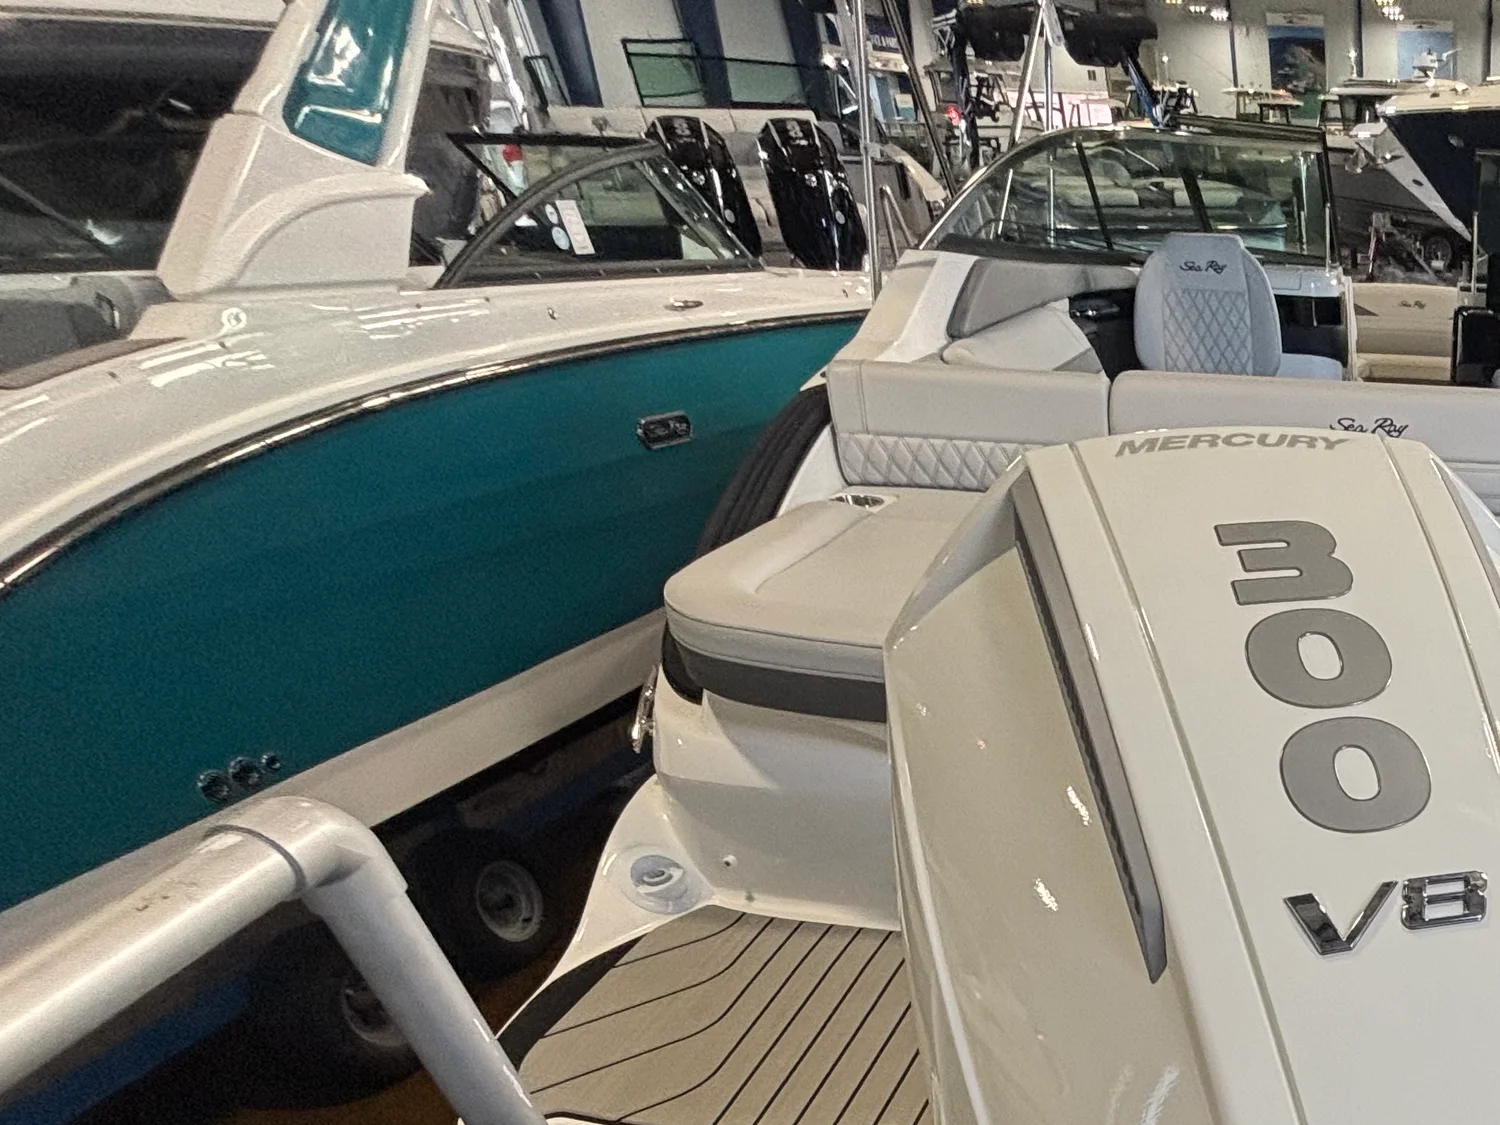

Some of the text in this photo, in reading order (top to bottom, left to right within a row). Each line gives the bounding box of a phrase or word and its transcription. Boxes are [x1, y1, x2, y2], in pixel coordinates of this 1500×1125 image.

[1179, 259, 1228, 275] Sea Ray
[1329, 417, 1409, 438] Sea Ray
[1115, 432, 1351, 457] MERCURY
[1213, 519, 1432, 834] 300
[1283, 869, 1488, 956] V8
